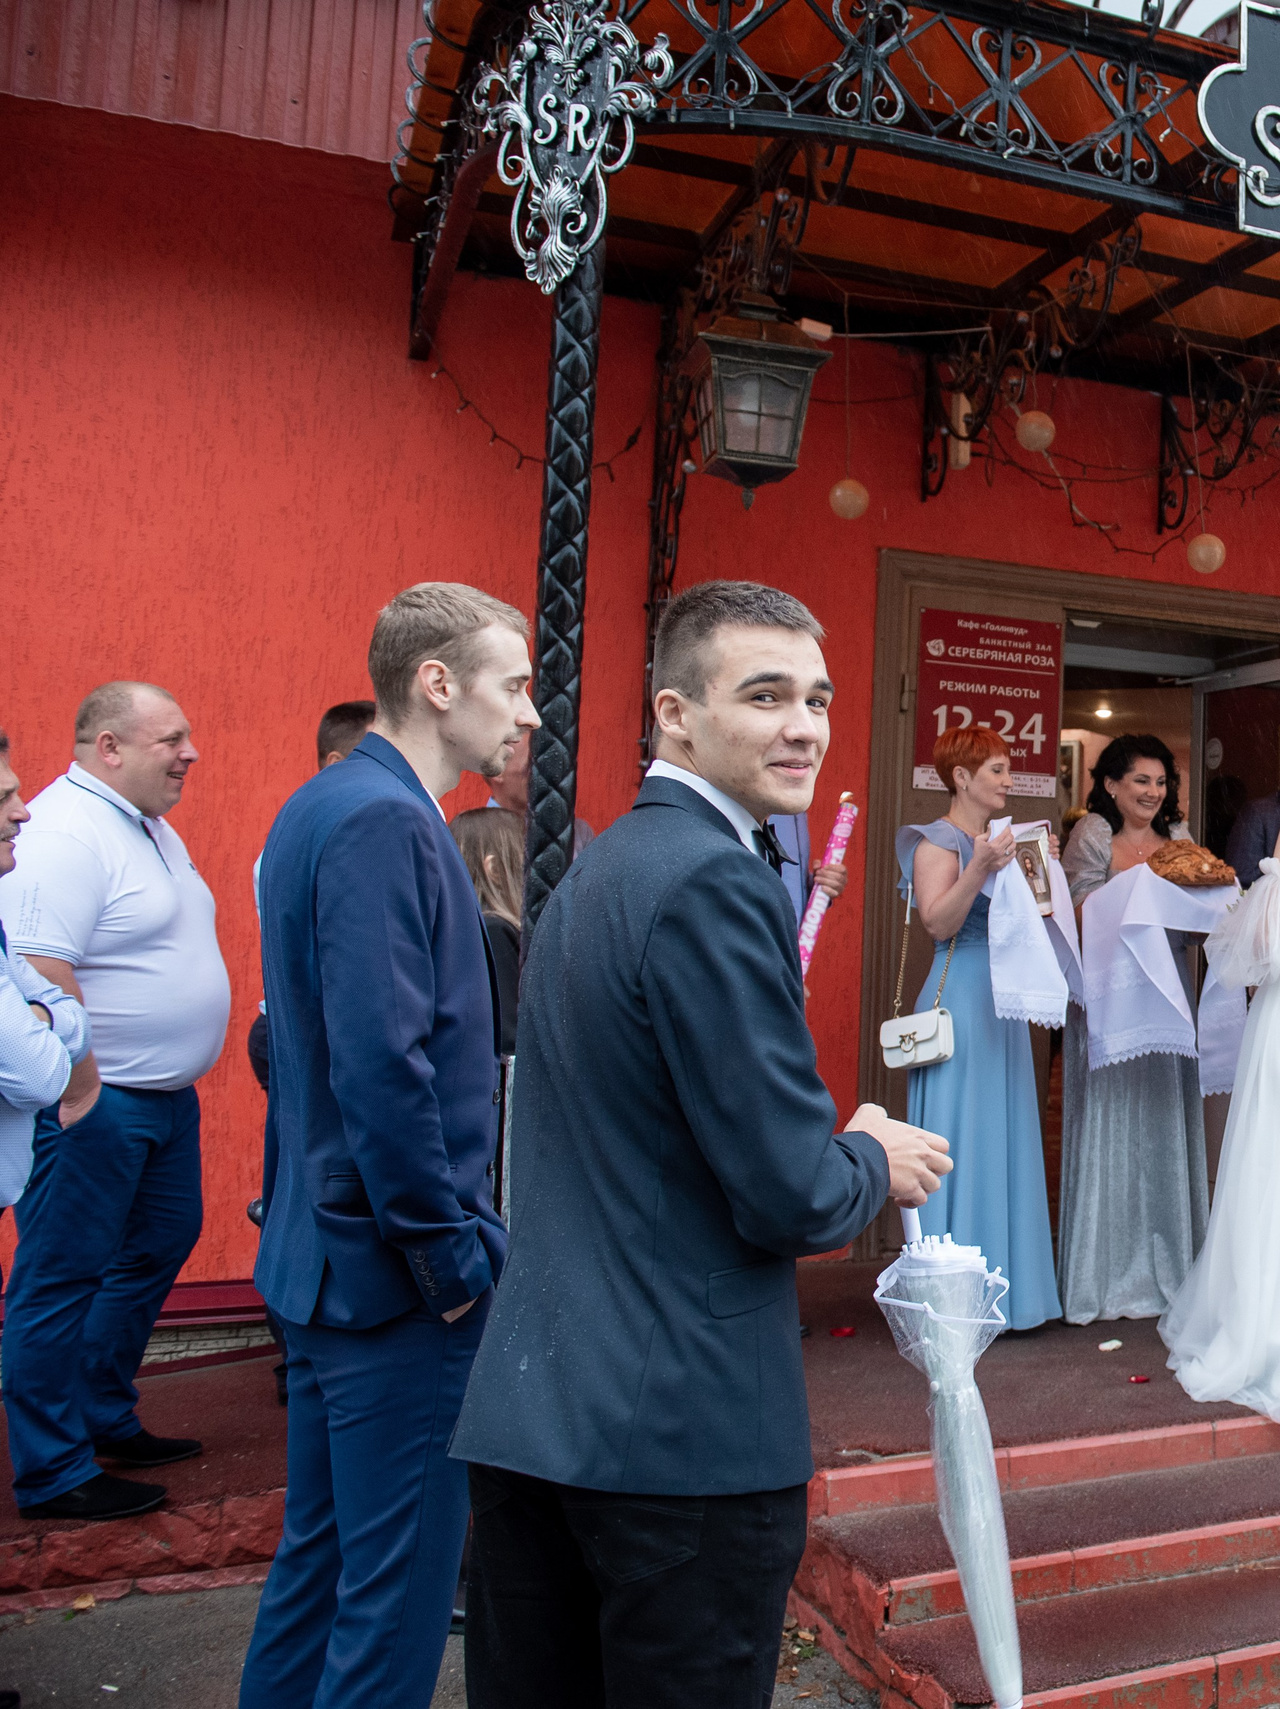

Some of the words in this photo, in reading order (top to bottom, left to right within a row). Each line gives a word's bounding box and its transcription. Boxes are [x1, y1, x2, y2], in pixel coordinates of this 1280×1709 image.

[957, 619, 980, 631] Кафе
[979, 636, 1032, 650] БАНКЕТНЫЙ
[1035, 642, 1052, 652] ЗАЛ
[947, 645, 1022, 664] СЕРЕБРЯНАЯ
[1024, 653, 1055, 667] РОЗА
[939, 680, 987, 694] РЕЖИМ
[989, 685, 1040, 699] РАБОТЫ
